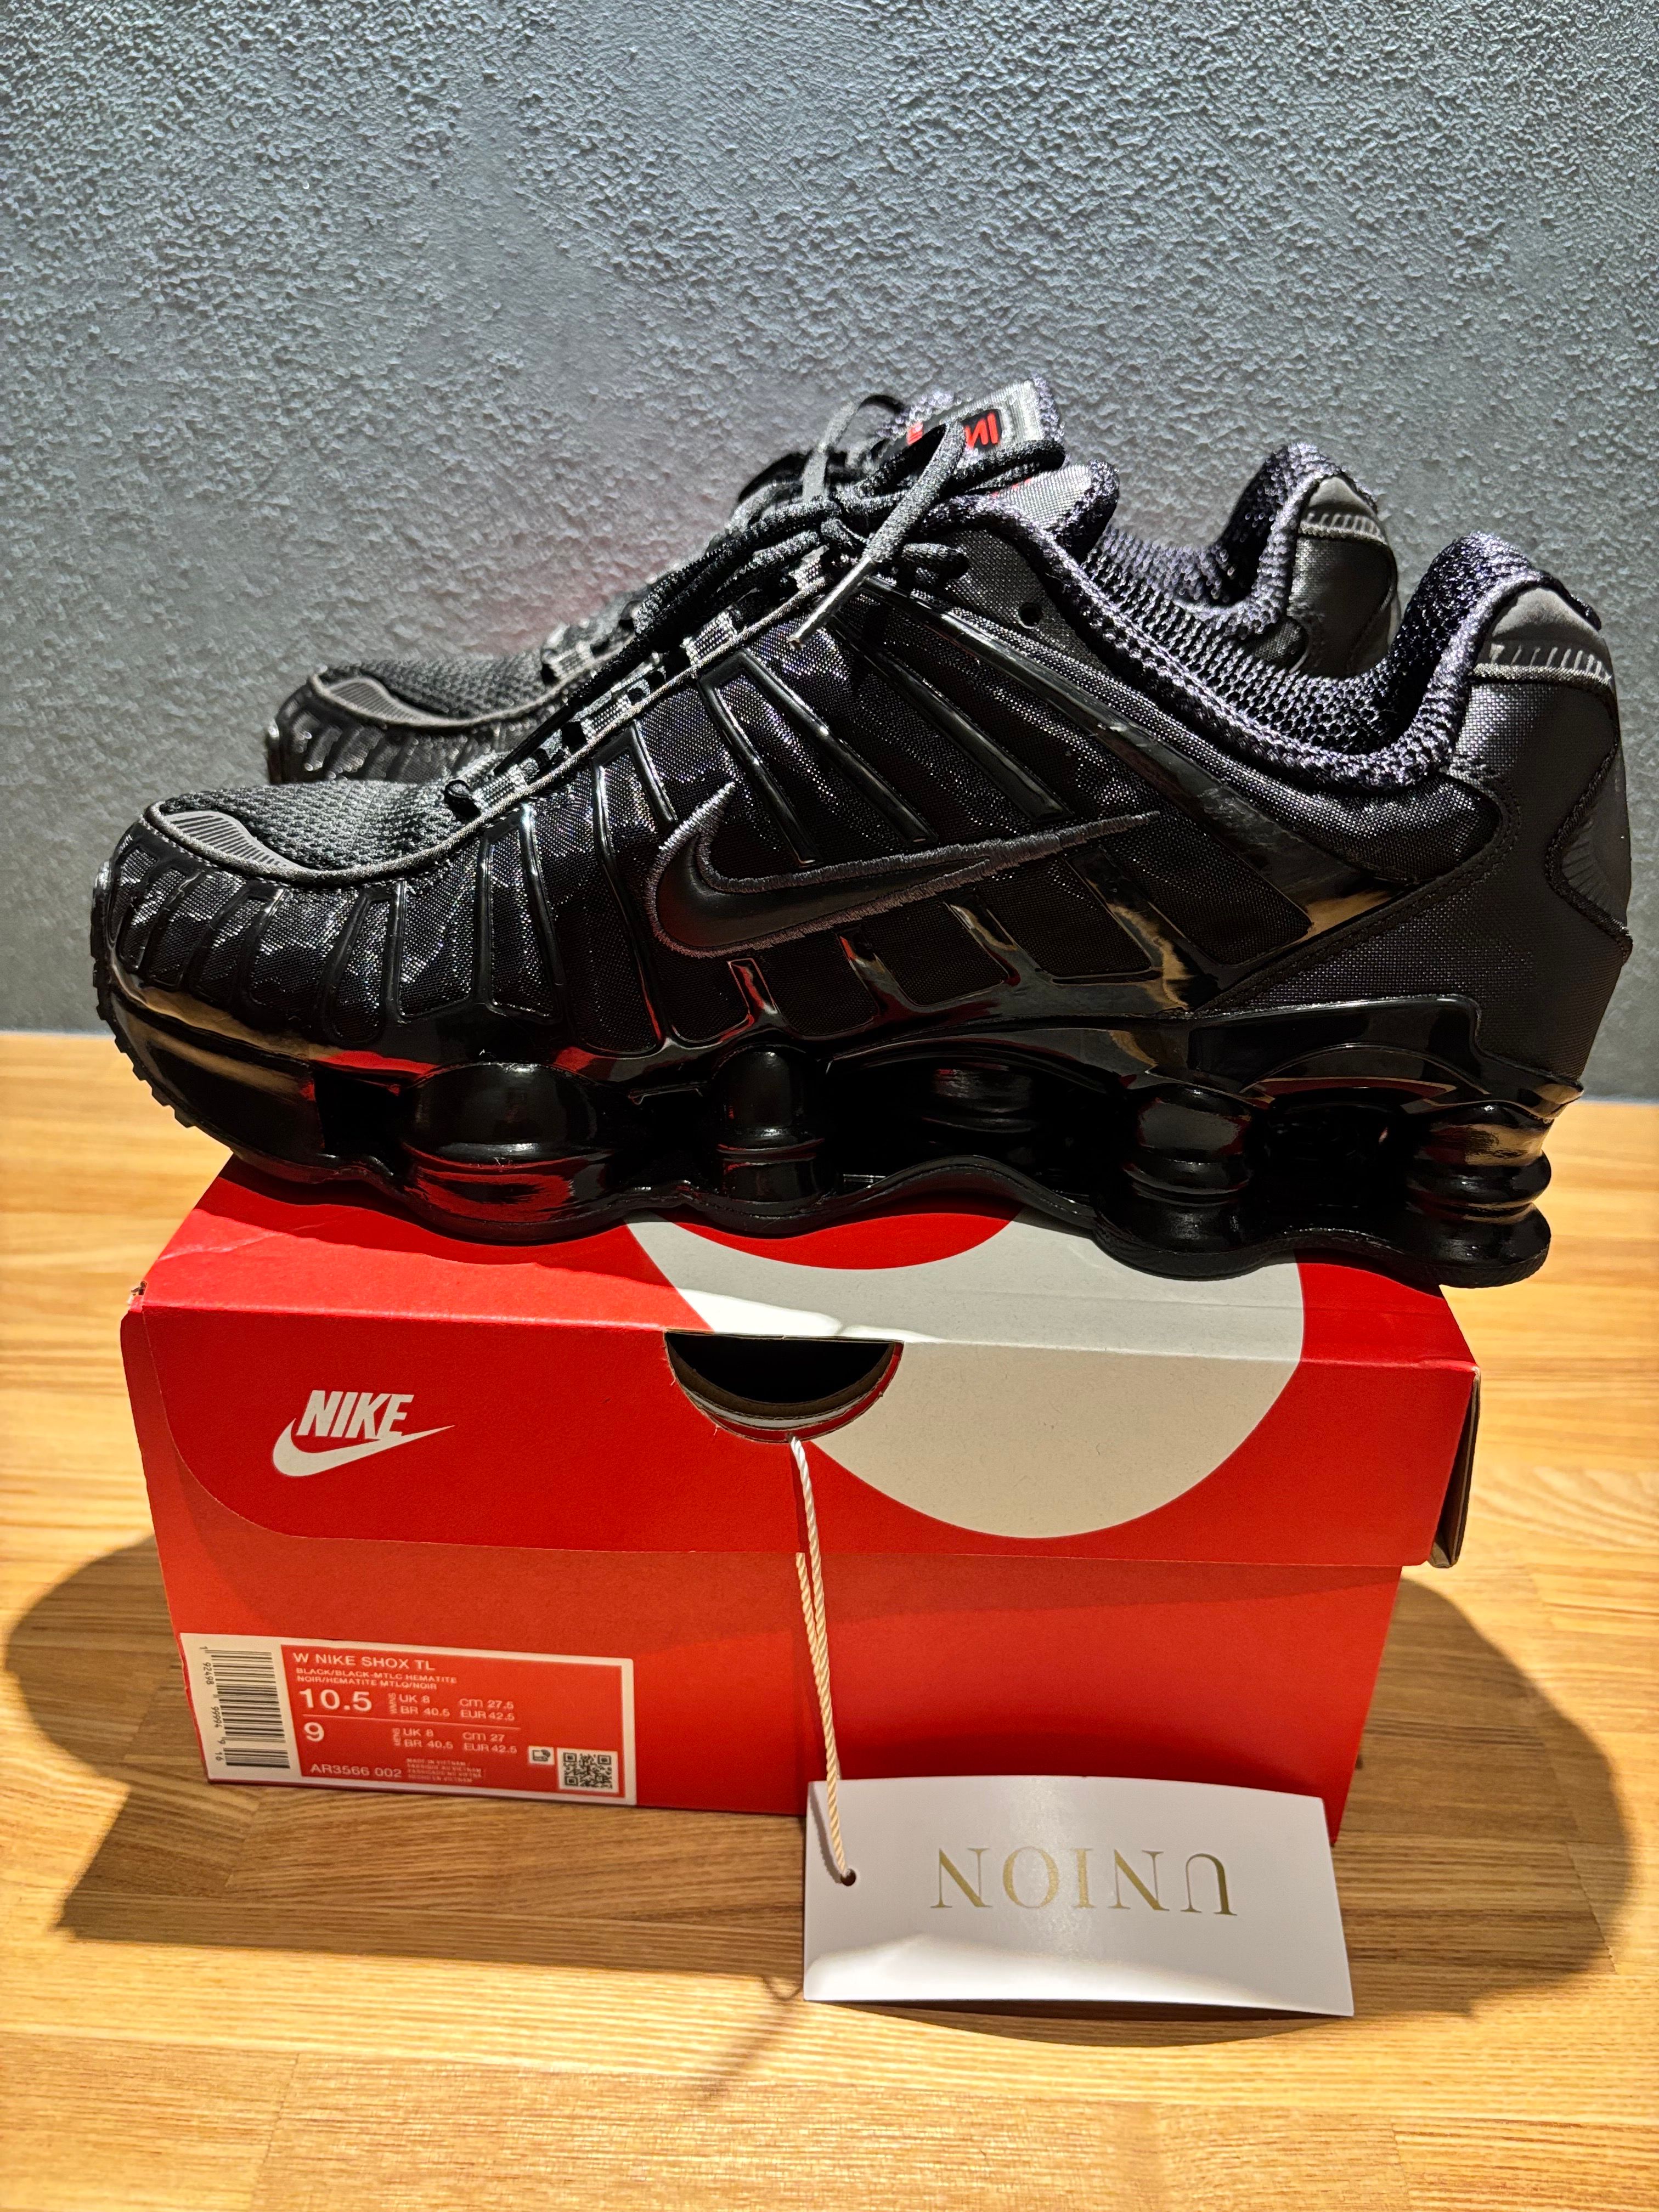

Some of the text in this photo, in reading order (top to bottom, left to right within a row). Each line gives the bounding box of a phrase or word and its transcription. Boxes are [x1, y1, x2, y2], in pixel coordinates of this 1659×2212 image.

[296, 1390, 415, 1440] NIKE
[293, 1652, 436, 1671] W NIKE SHOX TL
[203, 1662, 215, 1685] 92498
[296, 1668, 457, 1684] BLACK/BLACK-MTLC HEMATITE
[297, 1675, 377, 1686] NOIR/HEMATITE
[299, 1688, 372, 1712] 10.5
[399, 1694, 417, 1703] UK
[487, 1700, 514, 1710] 27.5
[400, 1706, 450, 1717] BR 40.5
[461, 1709, 515, 1722] EUR 42.5
[303, 1722, 325, 1742] 9
[403, 1728, 422, 1737] UK
[490, 1734, 505, 1742] 27
[404, 1739, 454, 1750] BR 40.5
[464, 1742, 517, 1754] EUR 42.5
[310, 1763, 370, 1776] AR3566
[374, 1767, 403, 1778] 002
[930, 1847, 1238, 1917] UNION
